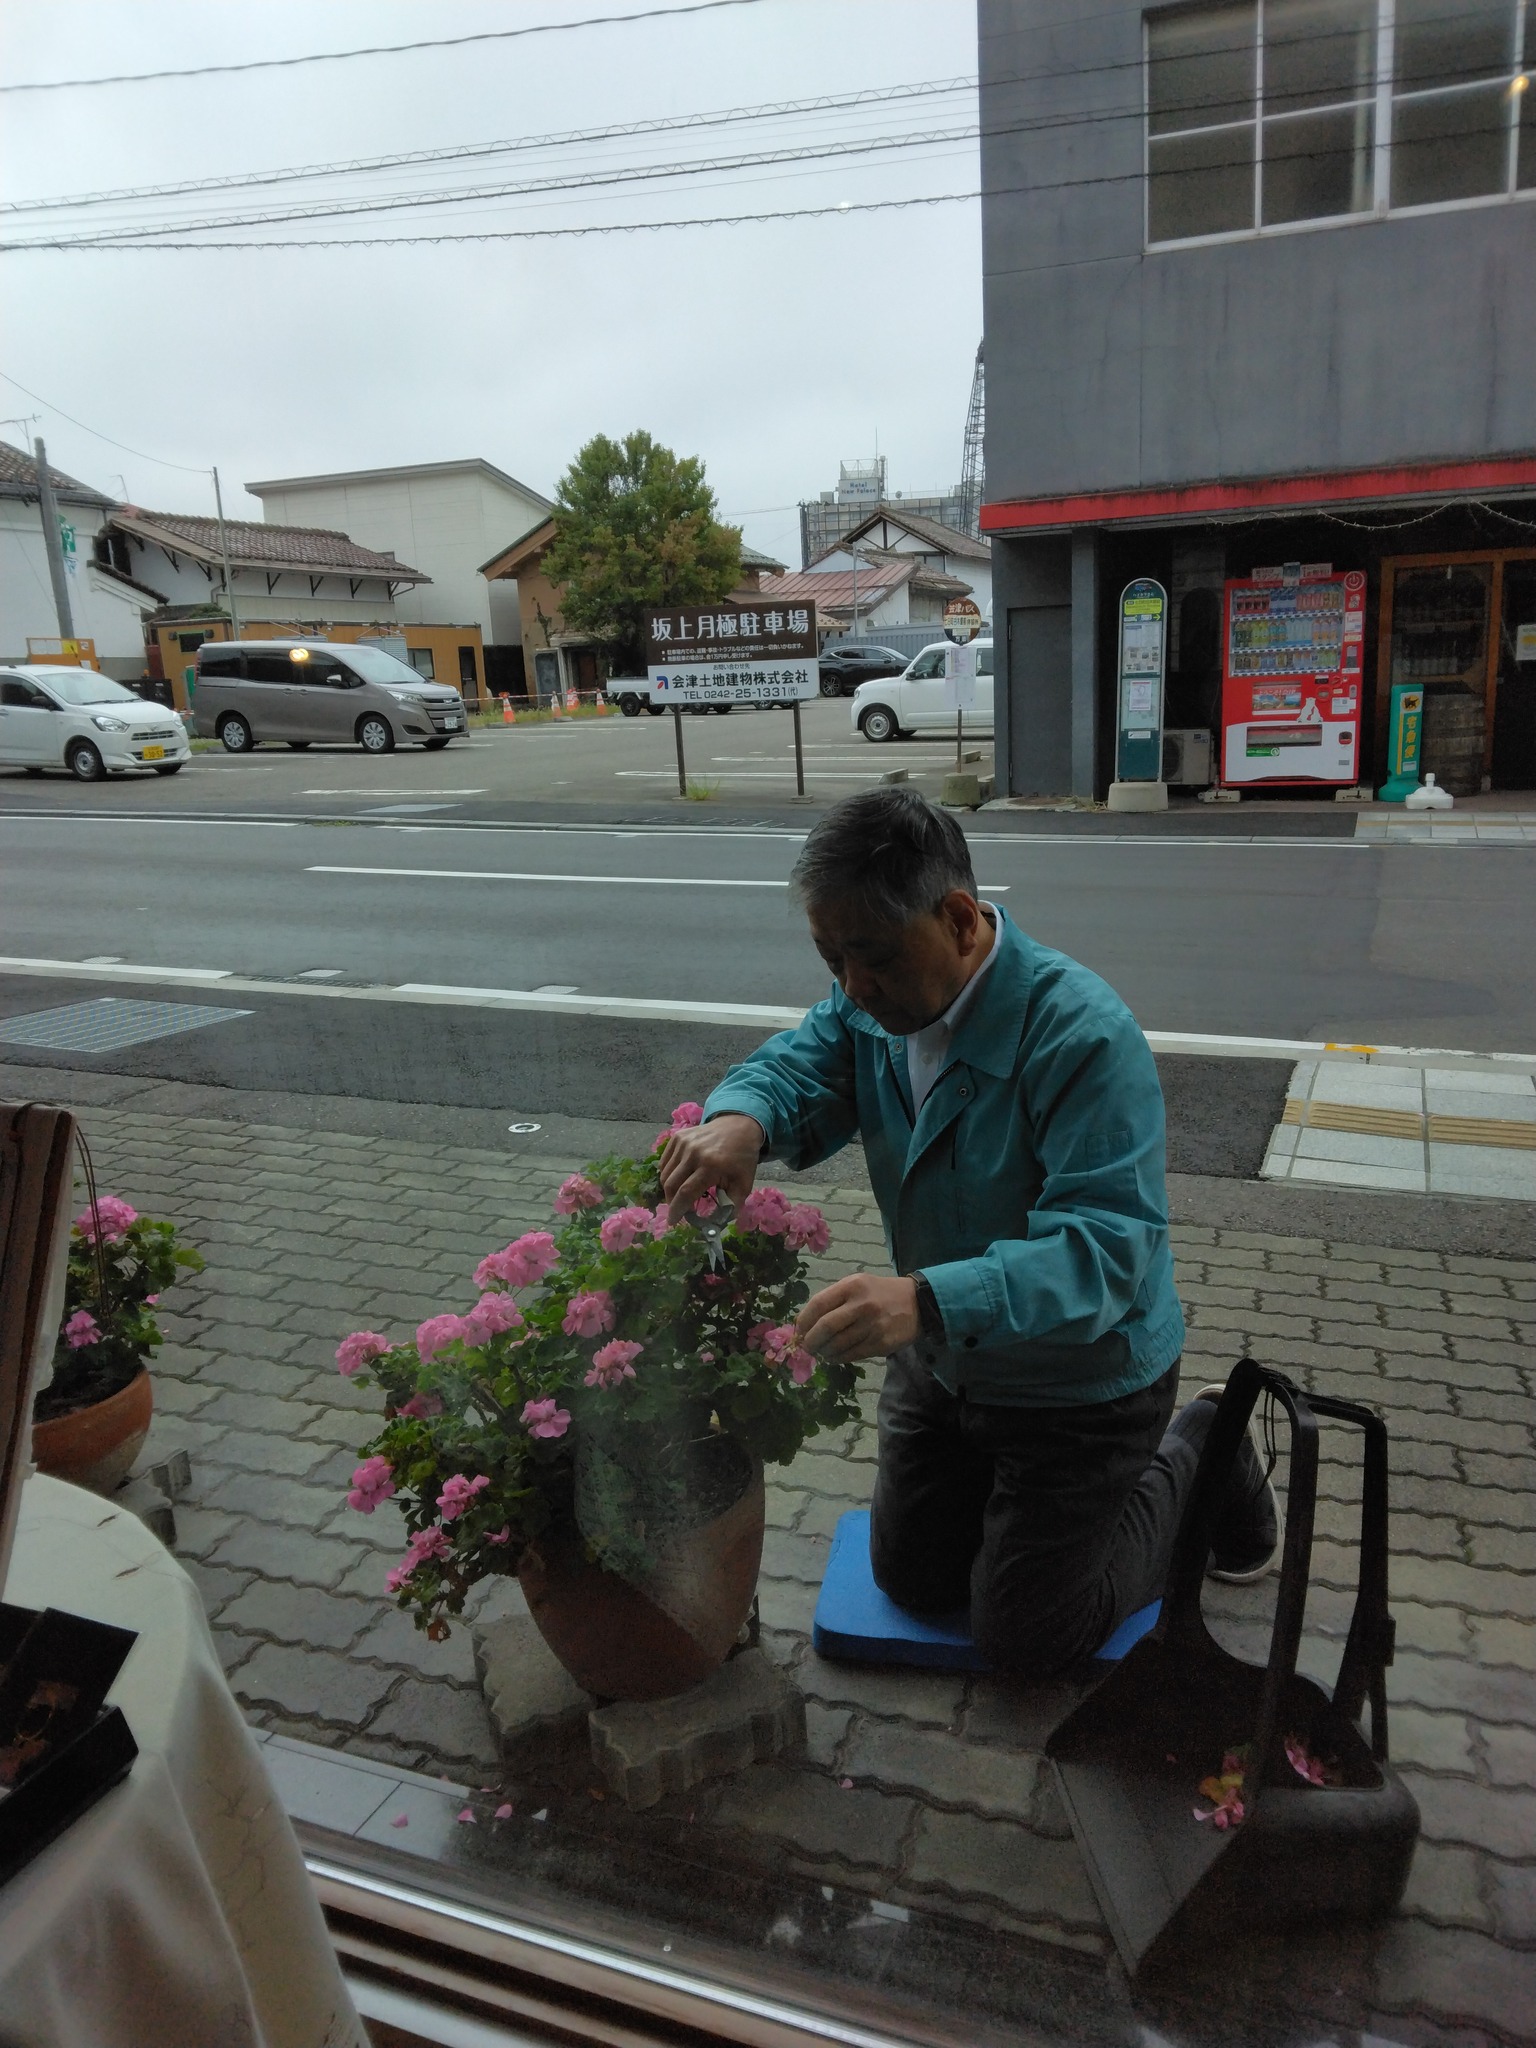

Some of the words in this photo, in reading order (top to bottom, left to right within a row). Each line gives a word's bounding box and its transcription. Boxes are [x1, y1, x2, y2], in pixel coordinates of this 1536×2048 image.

[651, 609, 809, 641] 坂上月極駐車場
[713, 663, 751, 671] お問い合わせ先
[672, 669, 809, 689] 会津土地建物株式会社
[683, 691, 702, 700] TEL
